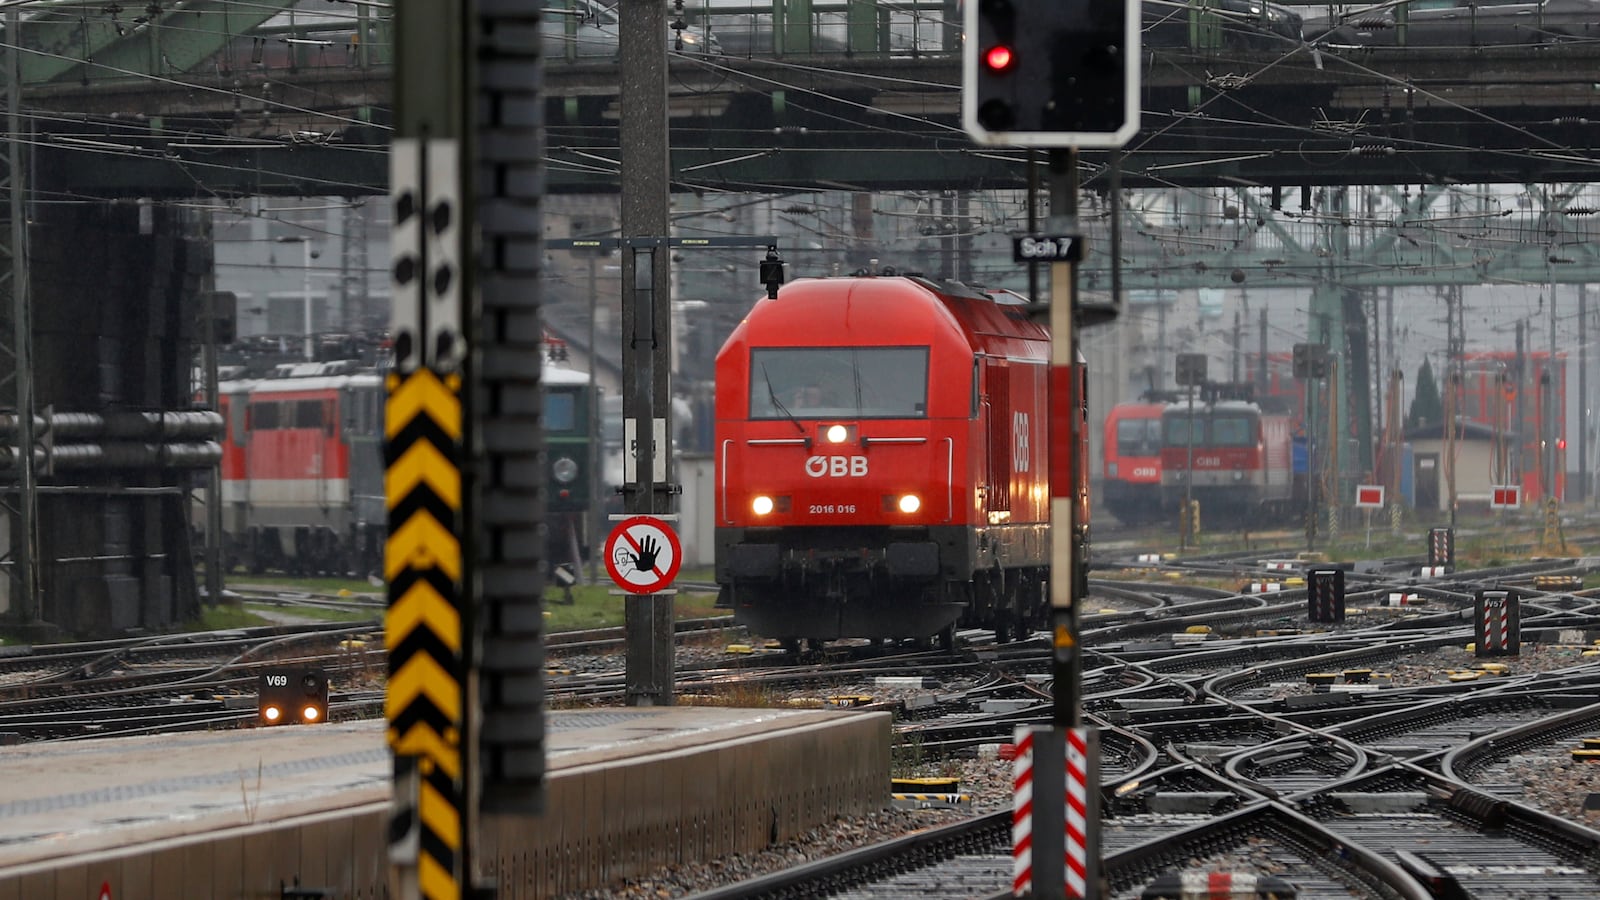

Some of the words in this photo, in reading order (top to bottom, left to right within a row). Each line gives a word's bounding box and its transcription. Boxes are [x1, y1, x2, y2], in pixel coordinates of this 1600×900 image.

[1058, 237, 1072, 257] 7
[805, 455, 868, 477] ÖBB
[809, 505, 834, 513] 2016
[837, 505, 856, 513] 016
[266, 675, 287, 686] V69
